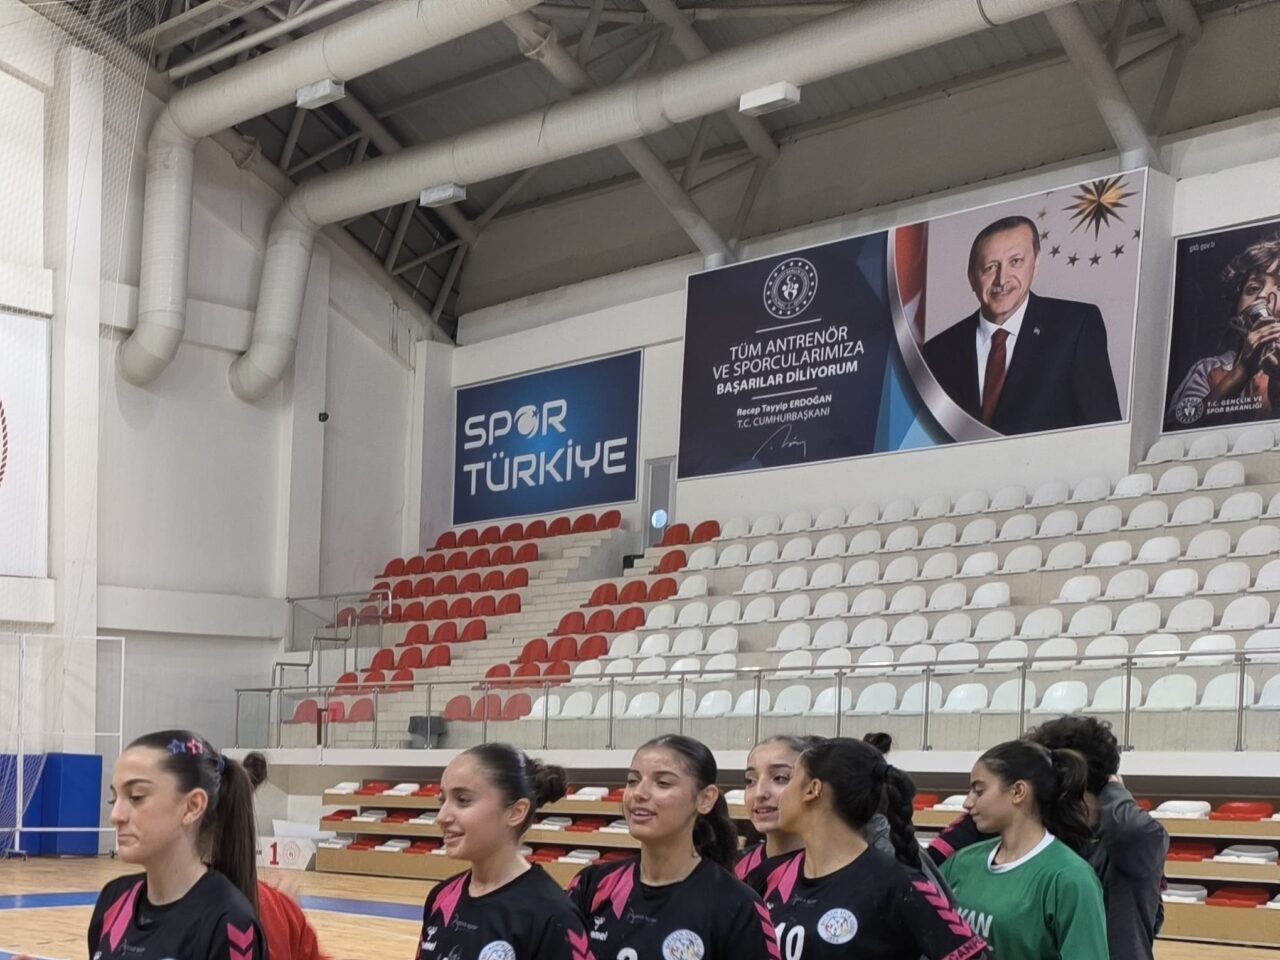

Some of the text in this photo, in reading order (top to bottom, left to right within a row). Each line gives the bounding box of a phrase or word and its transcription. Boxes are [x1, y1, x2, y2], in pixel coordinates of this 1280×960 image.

[712, 339, 865, 380] VE SPORCULARIMIZA
[729, 325, 849, 361] TÜM ANTRENÖR
[716, 359, 858, 396] BAŞARILAR DİLİYORUM
[736, 404, 761, 417] Recep
[789, 393, 833, 409] ERDOĞAN
[736, 406, 831, 430] T.C. CUMHURBAŞKANI
[463, 399, 567, 450] SPOR
[463, 437, 628, 496] TÜRKİYE
[270, 841, 279, 866] 1
